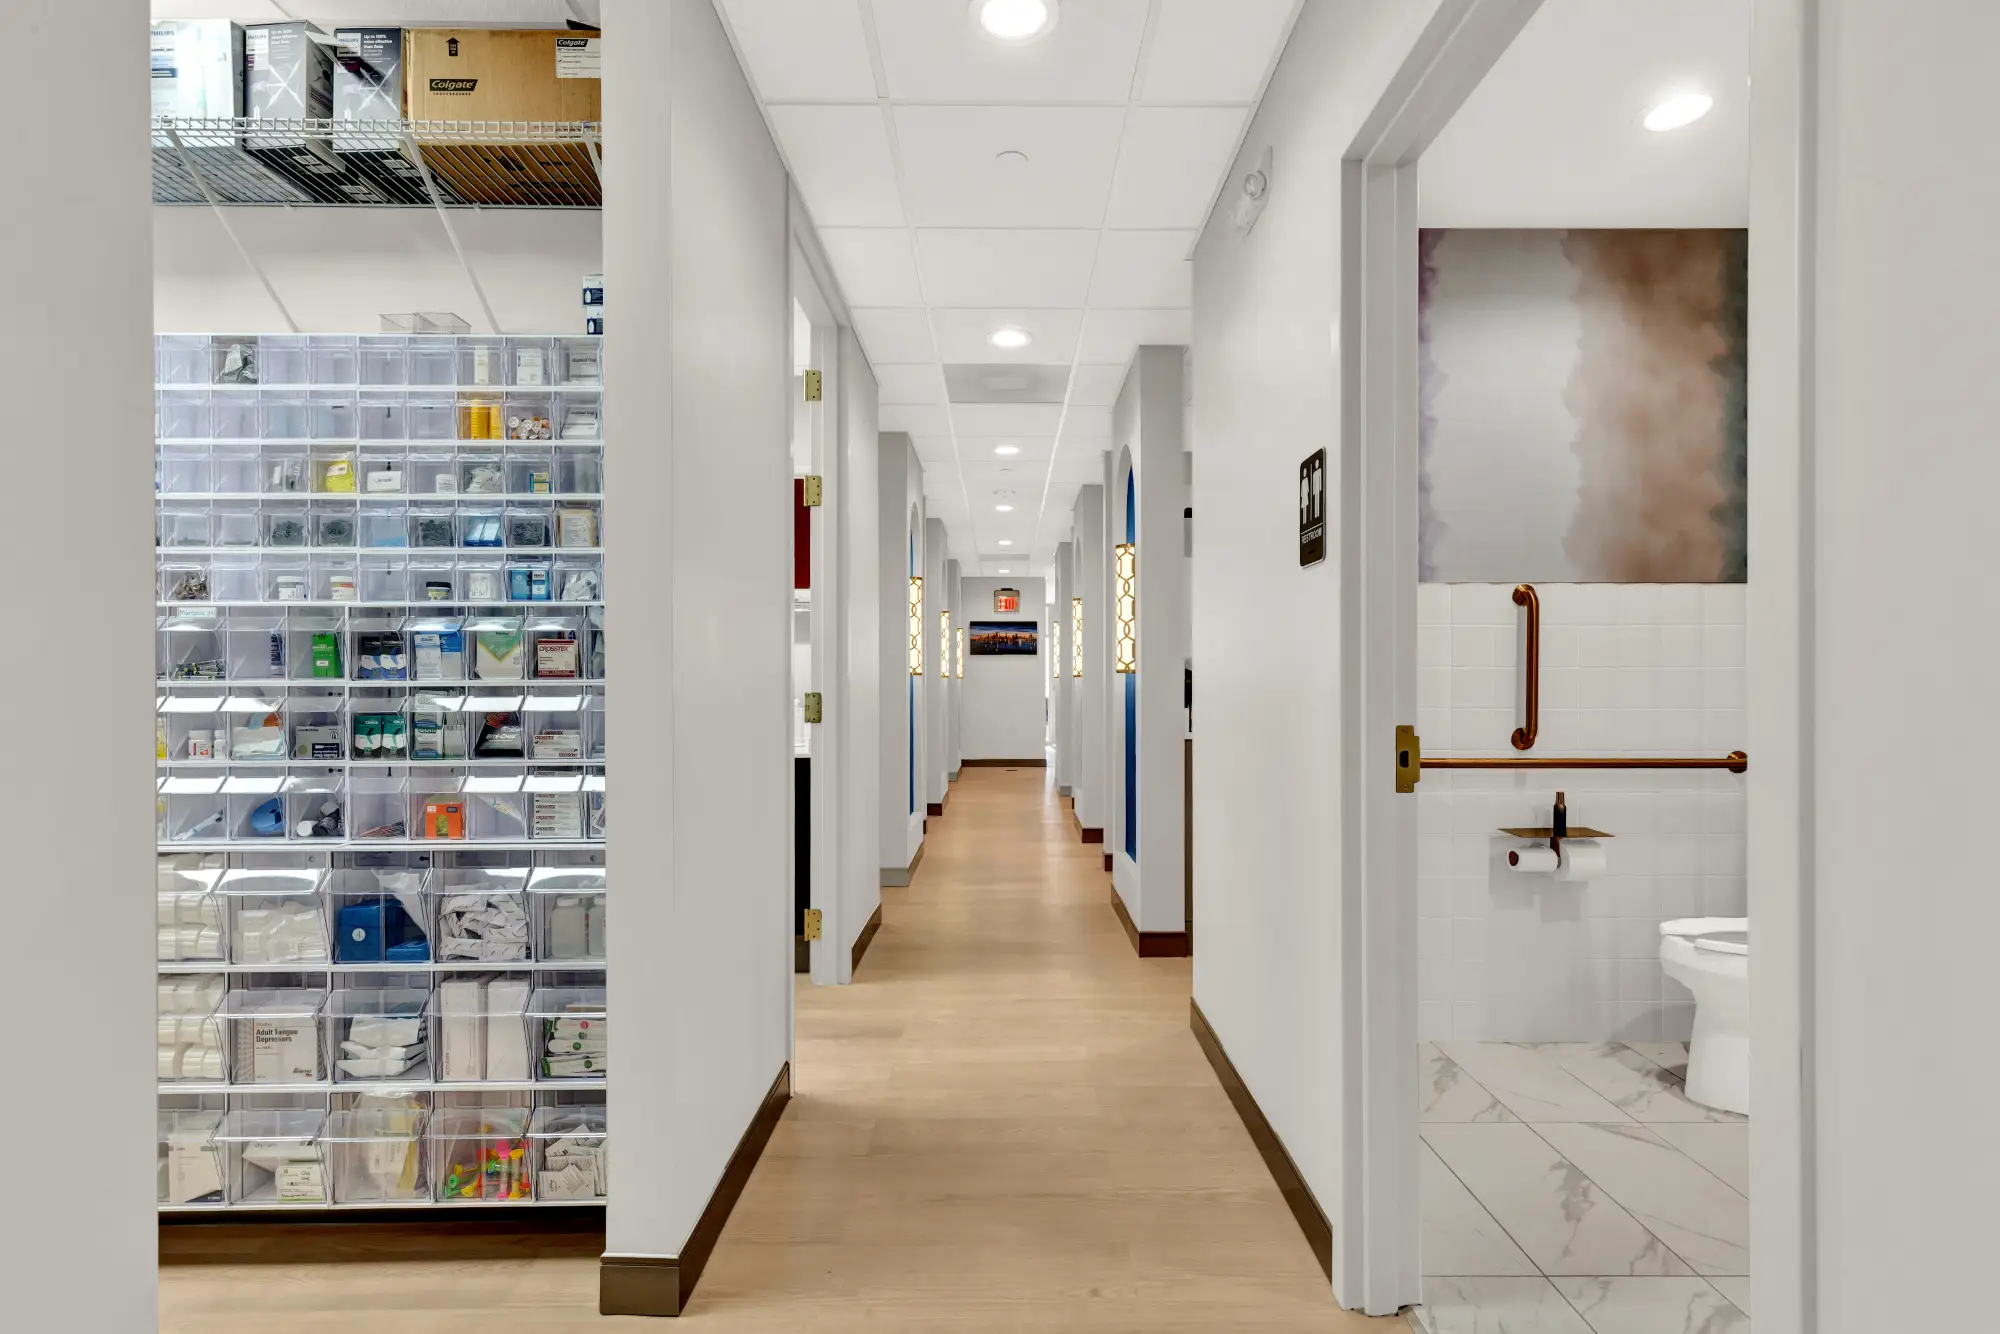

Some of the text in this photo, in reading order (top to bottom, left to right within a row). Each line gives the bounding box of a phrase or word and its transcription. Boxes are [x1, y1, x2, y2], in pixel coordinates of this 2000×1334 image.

[431, 80, 473, 90] Colgate
[1301, 527, 1323, 544] RESTROOM
[256, 1036, 292, 1044] Depressors
